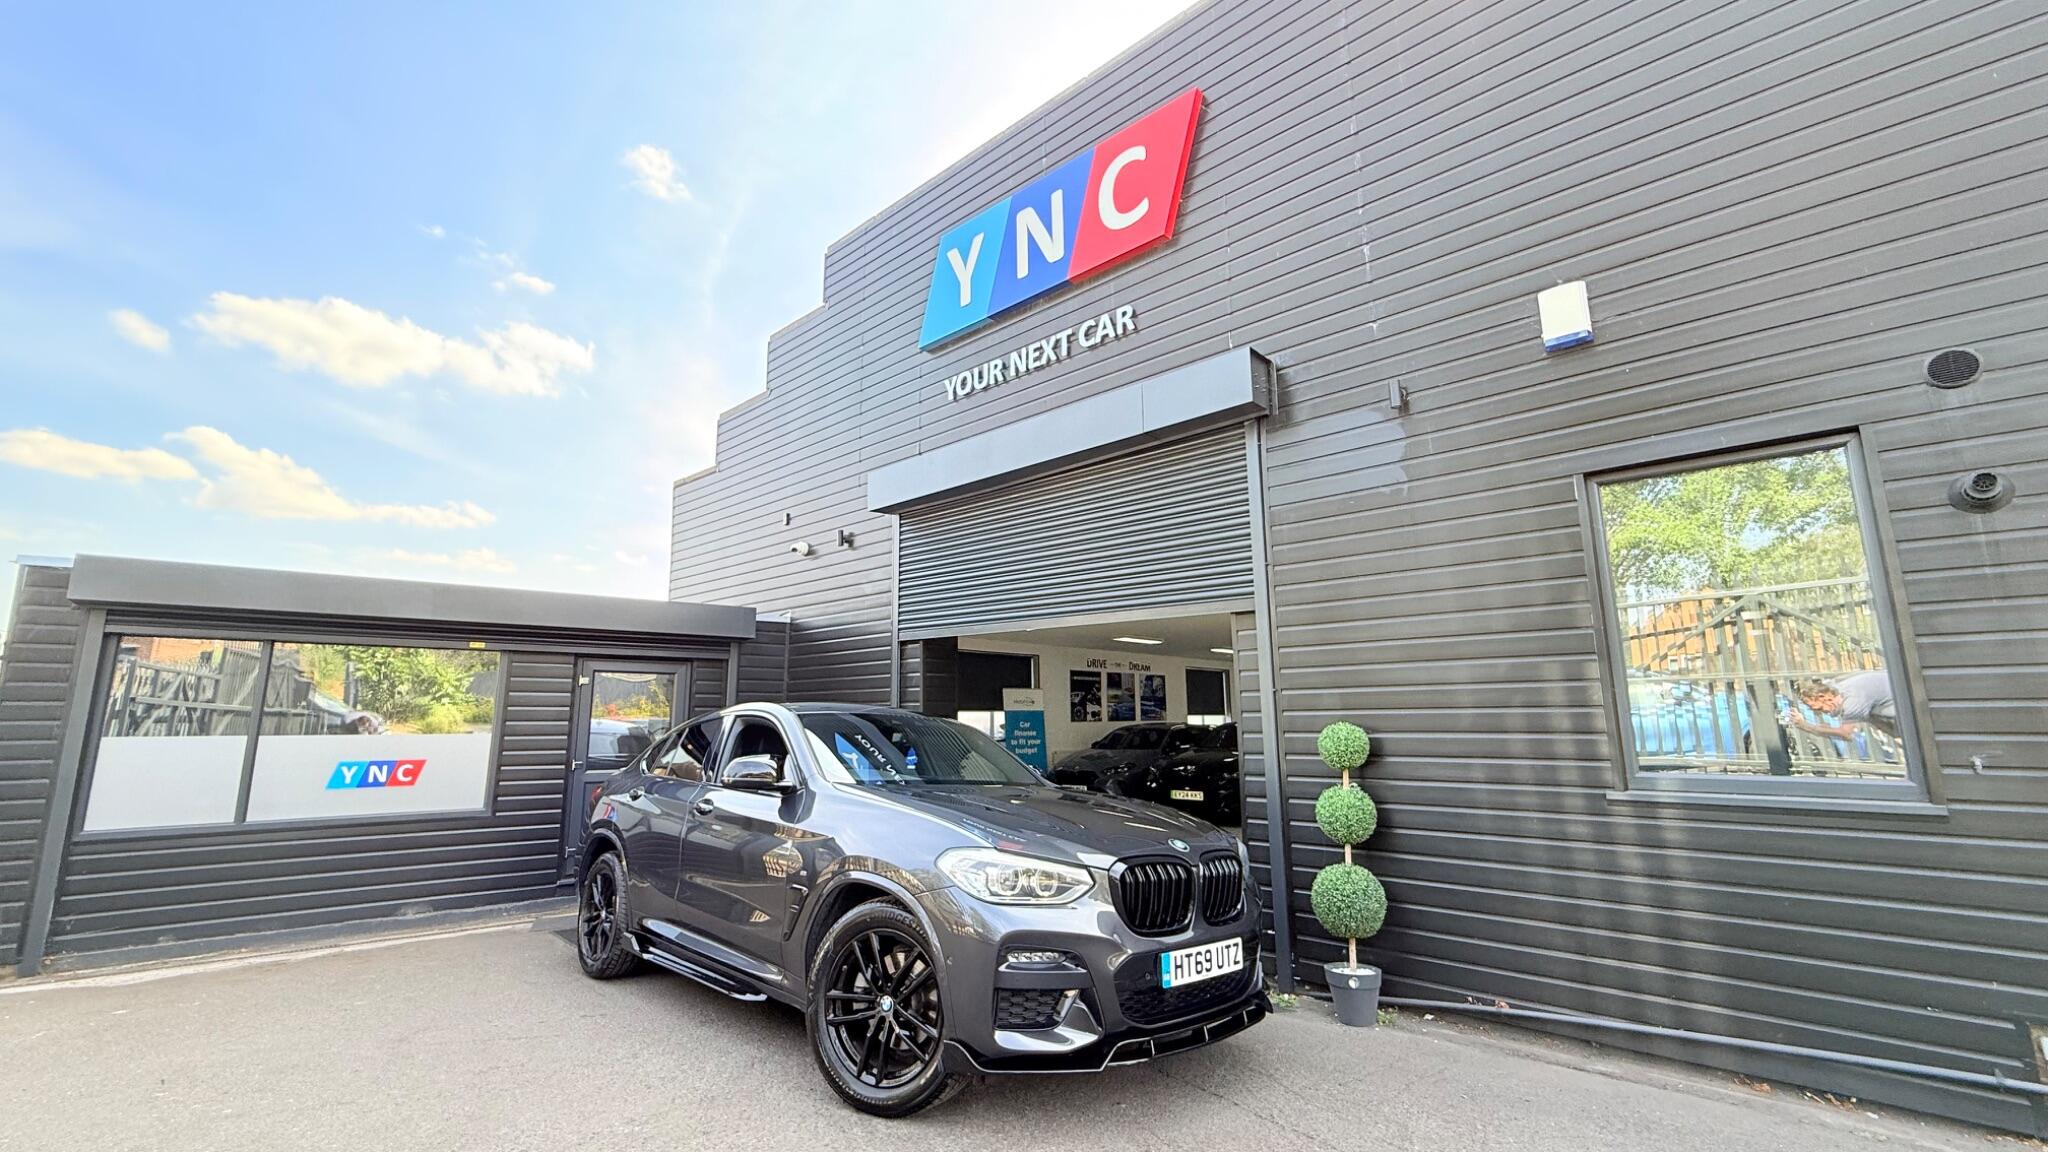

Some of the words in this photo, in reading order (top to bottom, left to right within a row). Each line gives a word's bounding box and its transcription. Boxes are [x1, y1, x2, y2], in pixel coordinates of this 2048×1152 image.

[946, 146, 1149, 307] YNC
[944, 359, 1004, 400] YOUR
[1009, 328, 1073, 376] NEXT
[1078, 304, 1136, 348] CAR
[1087, 658, 1107, 669] DRIVE
[1015, 747, 1038, 755] budget
[1027, 739, 1041, 747] your
[340, 764, 414, 784] YNC
[1174, 949, 1213, 980] HT69
[1216, 942, 1240, 970] UTZ
